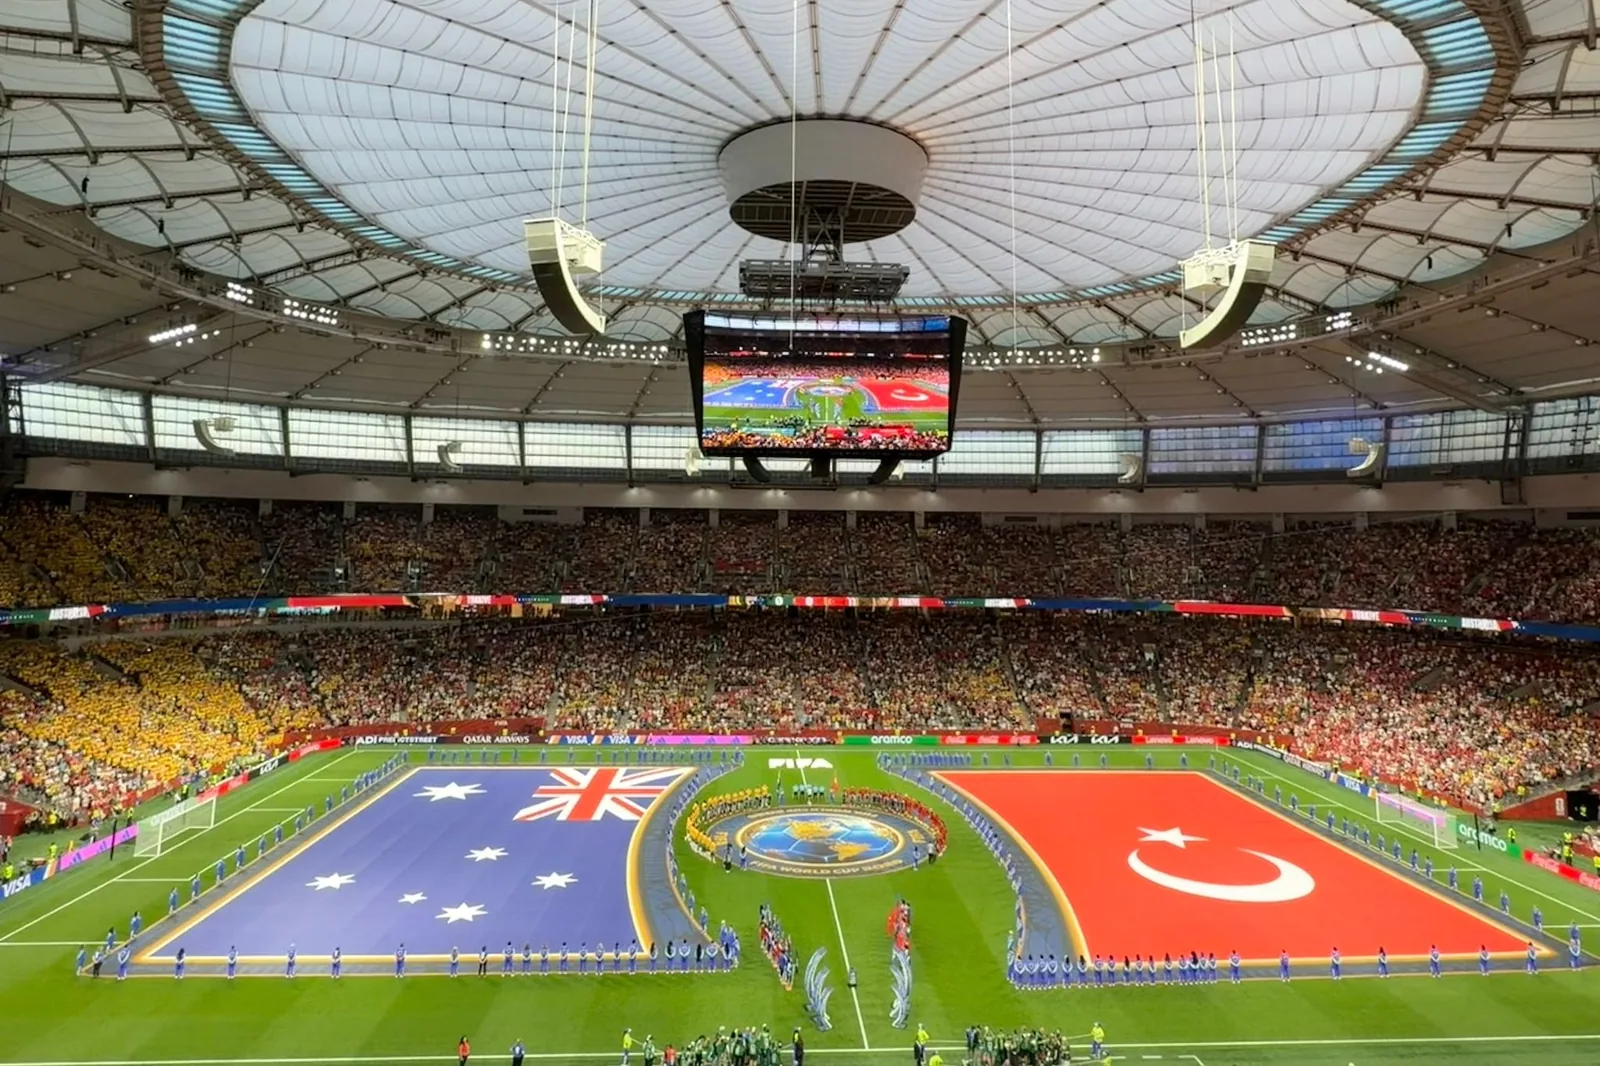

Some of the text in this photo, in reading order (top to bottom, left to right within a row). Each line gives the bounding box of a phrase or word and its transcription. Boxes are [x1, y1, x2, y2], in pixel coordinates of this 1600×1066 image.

[378, 736, 437, 744] PREICTSTREET
[463, 735, 530, 744] QATAR AIRWAYS
[566, 735, 588, 744] VISA
[608, 735, 631, 744] VISA
[871, 735, 913, 744] aramco
[1145, 736, 1173, 745] Lenovo
[1185, 736, 1214, 745] Lenovo
[768, 758, 834, 769] FIFA
[1458, 823, 1507, 851] aramco
[781, 866, 831, 875] WORLD
[833, 866, 860, 874] CUP
[2, 873, 31, 897] VISA
